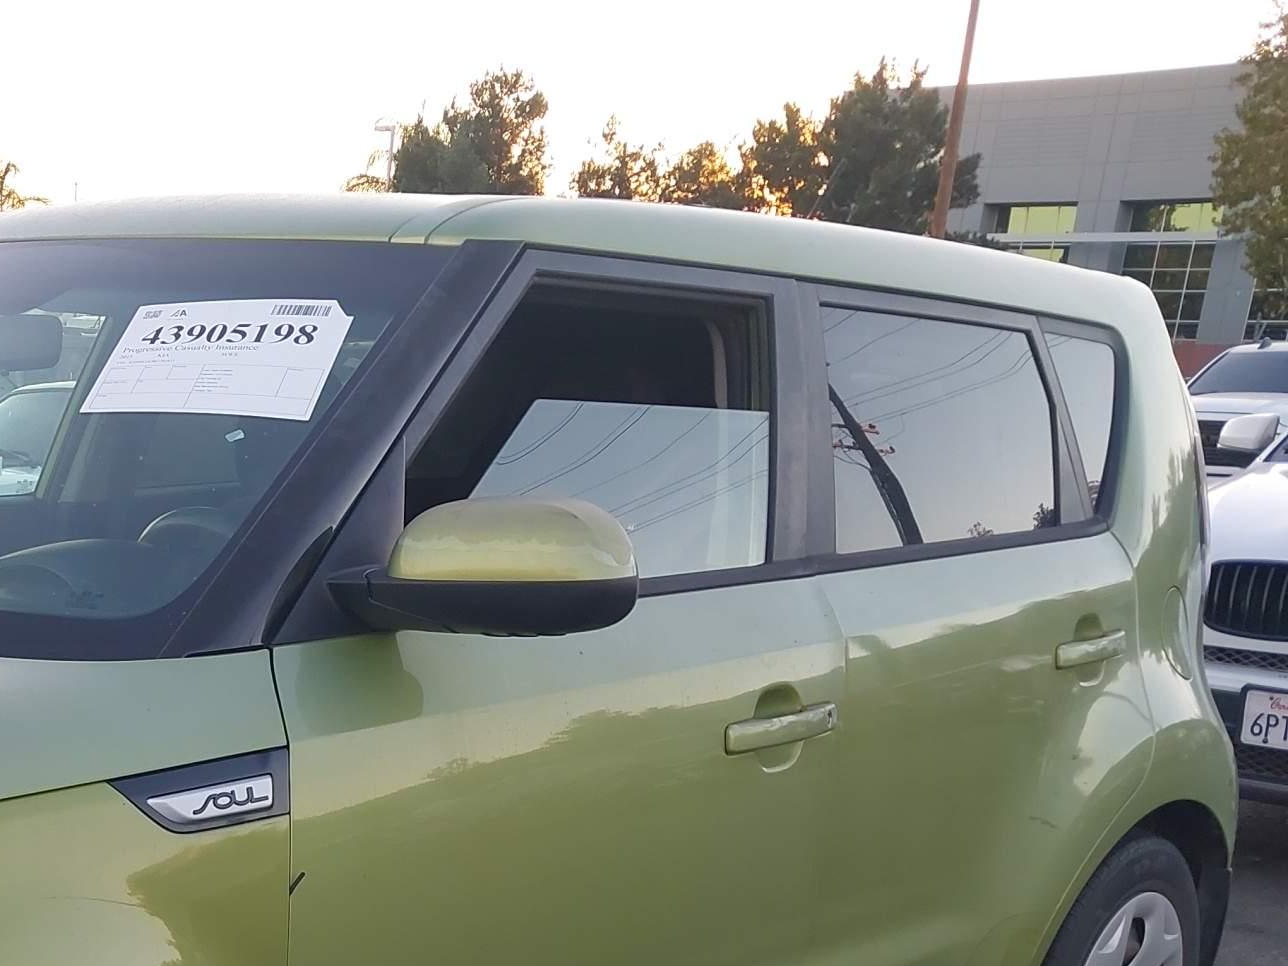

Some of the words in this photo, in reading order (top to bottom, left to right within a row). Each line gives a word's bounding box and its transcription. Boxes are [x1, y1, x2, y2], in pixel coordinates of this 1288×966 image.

[141, 323, 319, 345] 43905198
[122, 346, 173, 354] Progressive
[174, 344, 213, 353] Casualty
[215, 344, 260, 352] Insurance
[193, 787, 269, 815] SOUL
